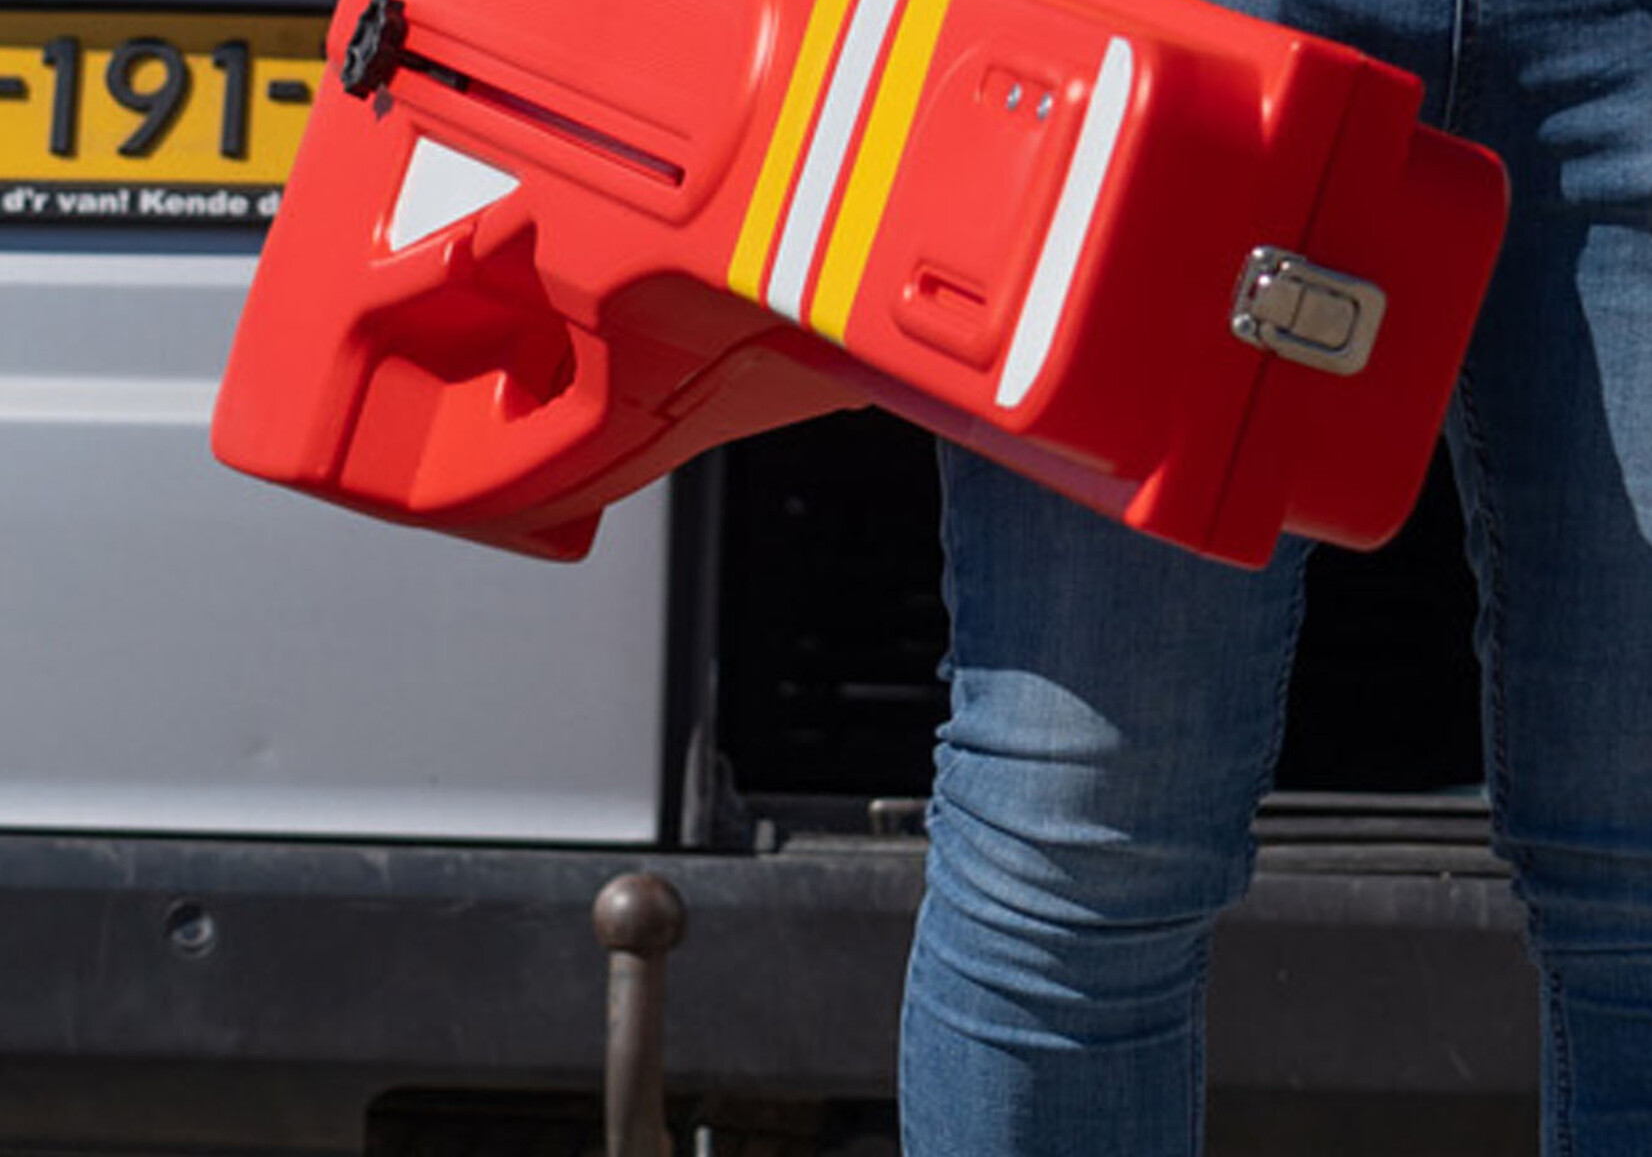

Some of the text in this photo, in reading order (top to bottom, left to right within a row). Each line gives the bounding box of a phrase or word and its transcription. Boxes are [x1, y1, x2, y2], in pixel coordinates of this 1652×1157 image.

[3, 188, 48, 213] d'r
[57, 189, 130, 214] van!
[139, 189, 249, 215] Kende
